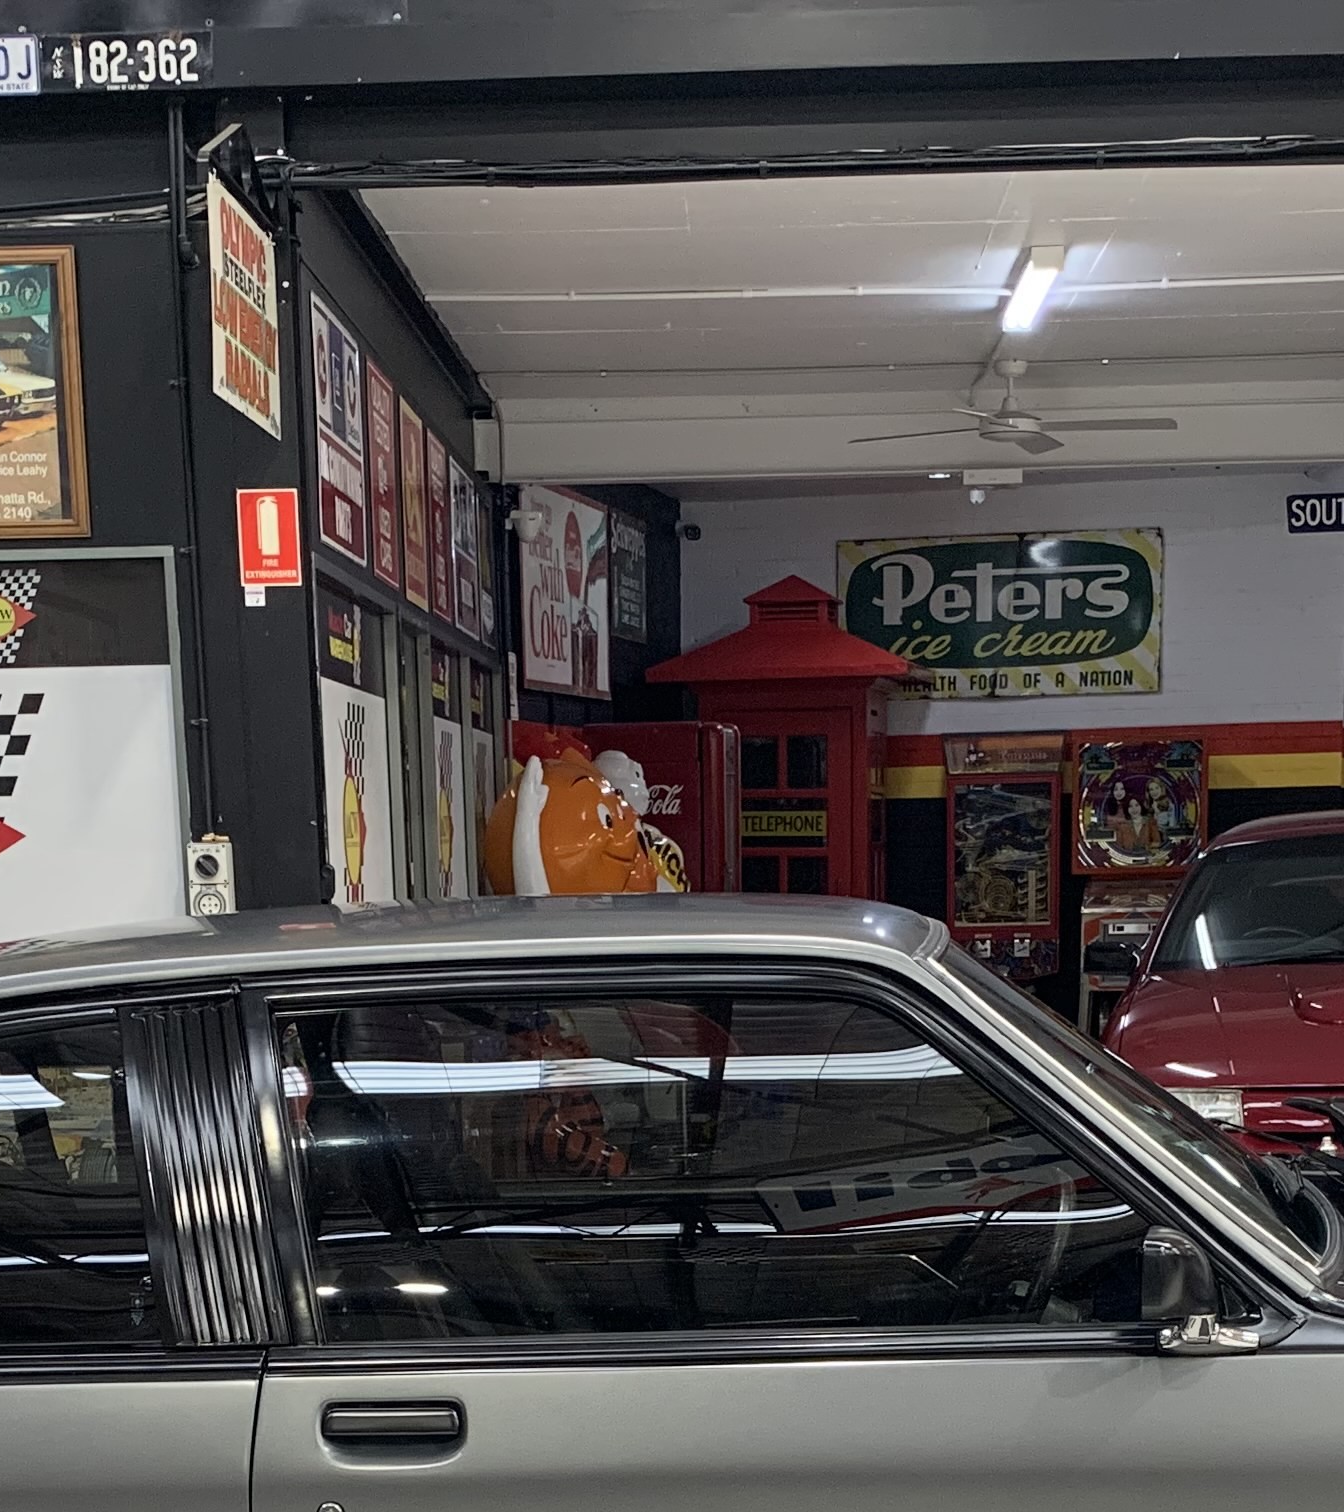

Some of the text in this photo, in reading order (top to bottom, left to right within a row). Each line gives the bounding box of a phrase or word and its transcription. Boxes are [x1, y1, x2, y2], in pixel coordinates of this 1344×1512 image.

[6, 82, 31, 91] STATE
[224, 252, 267, 315] STEELFLEX
[10, 451, 47, 463] Connor
[17, 465, 48, 478] Leahy
[4, 507, 32, 519] 2140
[262, 558, 279, 568] FIRE
[539, 548, 564, 603] with
[870, 553, 1130, 625] Peters
[529, 585, 568, 663] Coke
[890, 620, 1116, 660] ice cream
[1023, 673, 1041, 689] OF
[1055, 672, 1065, 687] A
[1079, 669, 1134, 687] NATION
[742, 815, 824, 833] TELEPHONE
